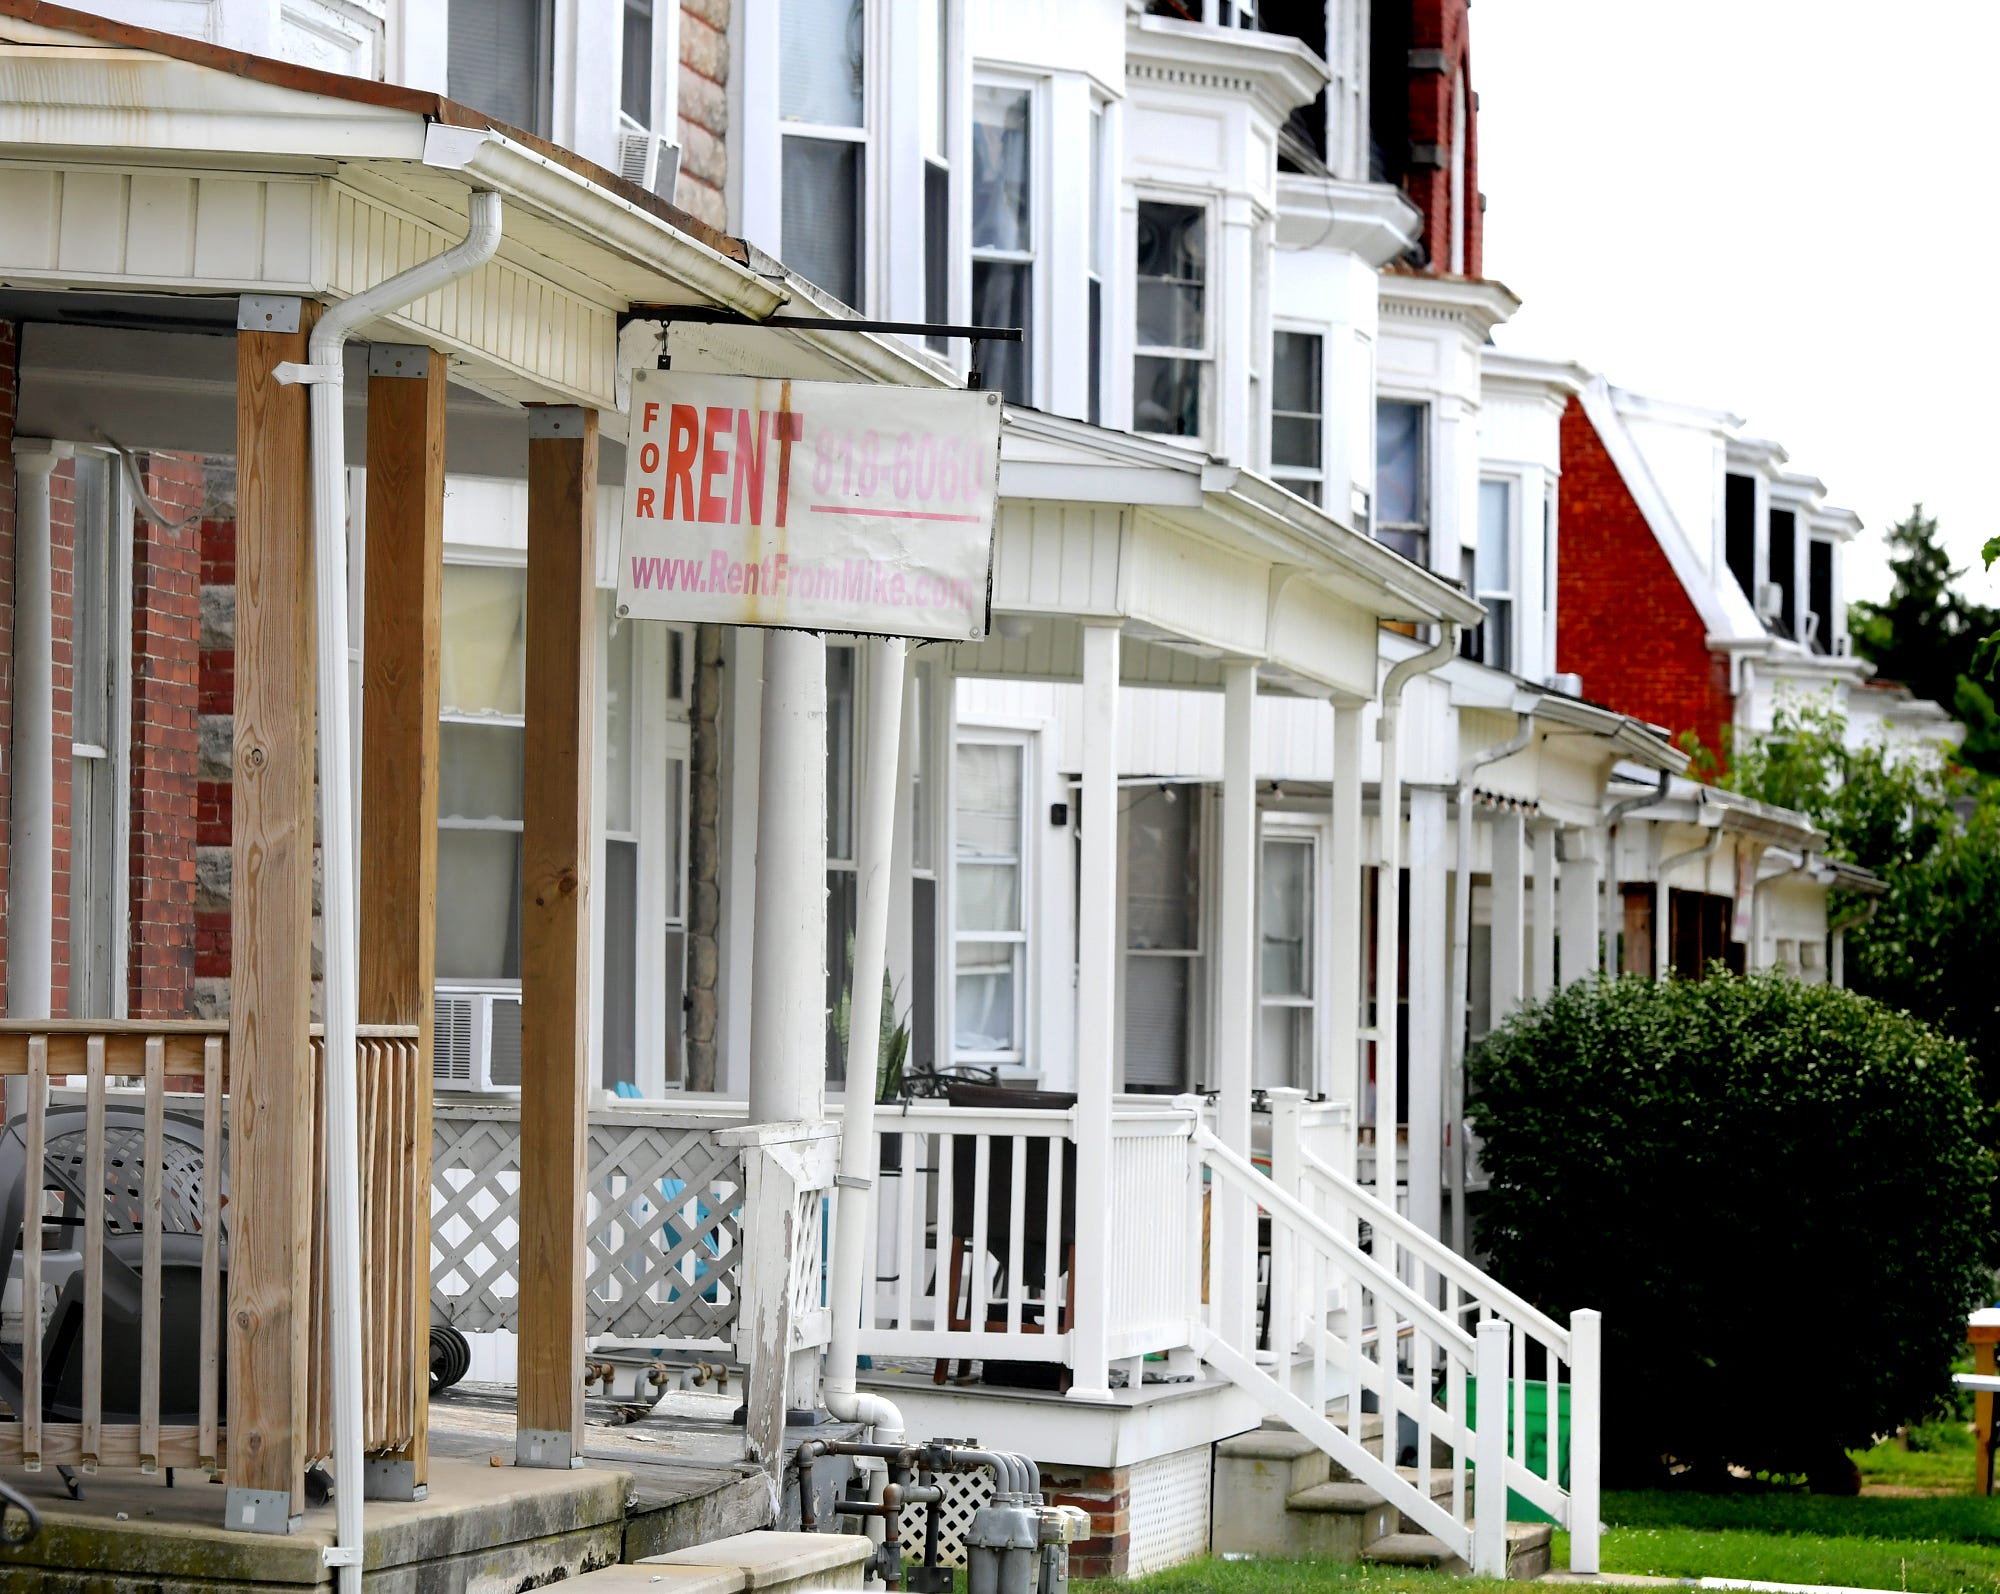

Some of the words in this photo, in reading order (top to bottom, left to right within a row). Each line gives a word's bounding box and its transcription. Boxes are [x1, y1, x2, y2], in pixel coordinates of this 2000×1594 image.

[636, 401, 661, 519] FOR
[662, 402, 804, 528] RENT
[812, 428, 983, 503] 818-6060
[631, 550, 973, 610] www.RentFromMike.com
